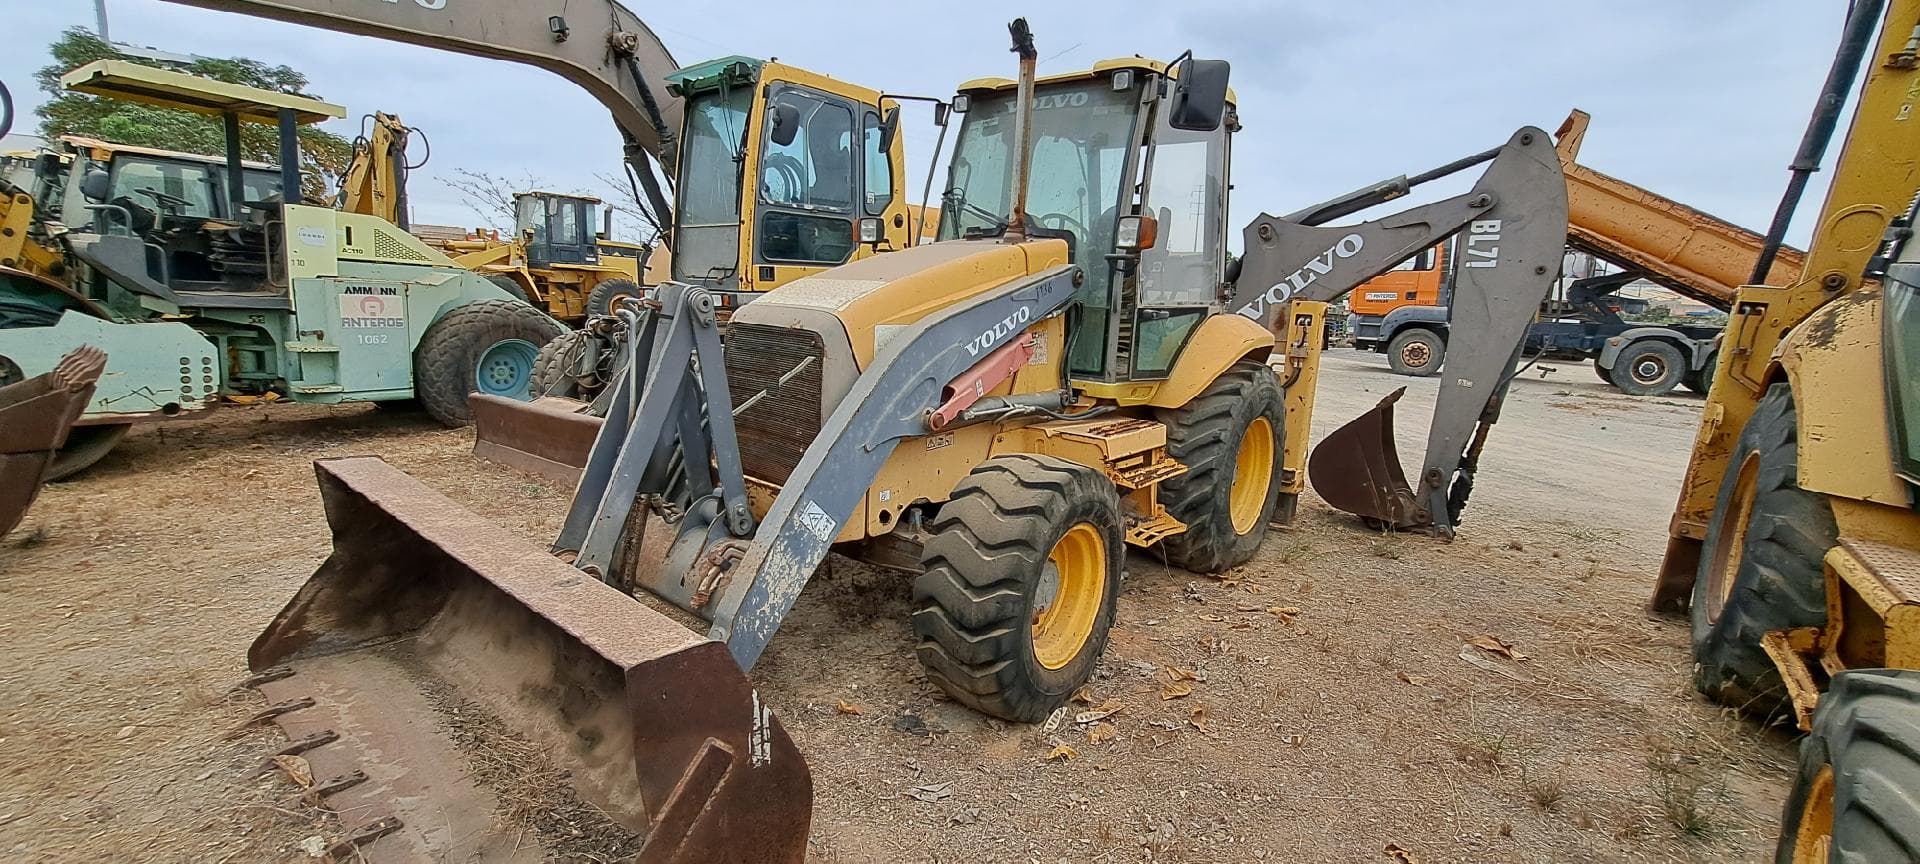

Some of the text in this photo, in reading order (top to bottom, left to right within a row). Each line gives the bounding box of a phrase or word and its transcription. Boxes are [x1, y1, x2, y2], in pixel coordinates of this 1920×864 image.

[1005, 91, 1088, 113] VLVO
[1236, 234, 1364, 321] VOLVO
[344, 286, 397, 295] AMMANN
[341, 317, 404, 328] ANTEROS
[965, 305, 1030, 357] VOLVO
[358, 334, 389, 345] 1062
